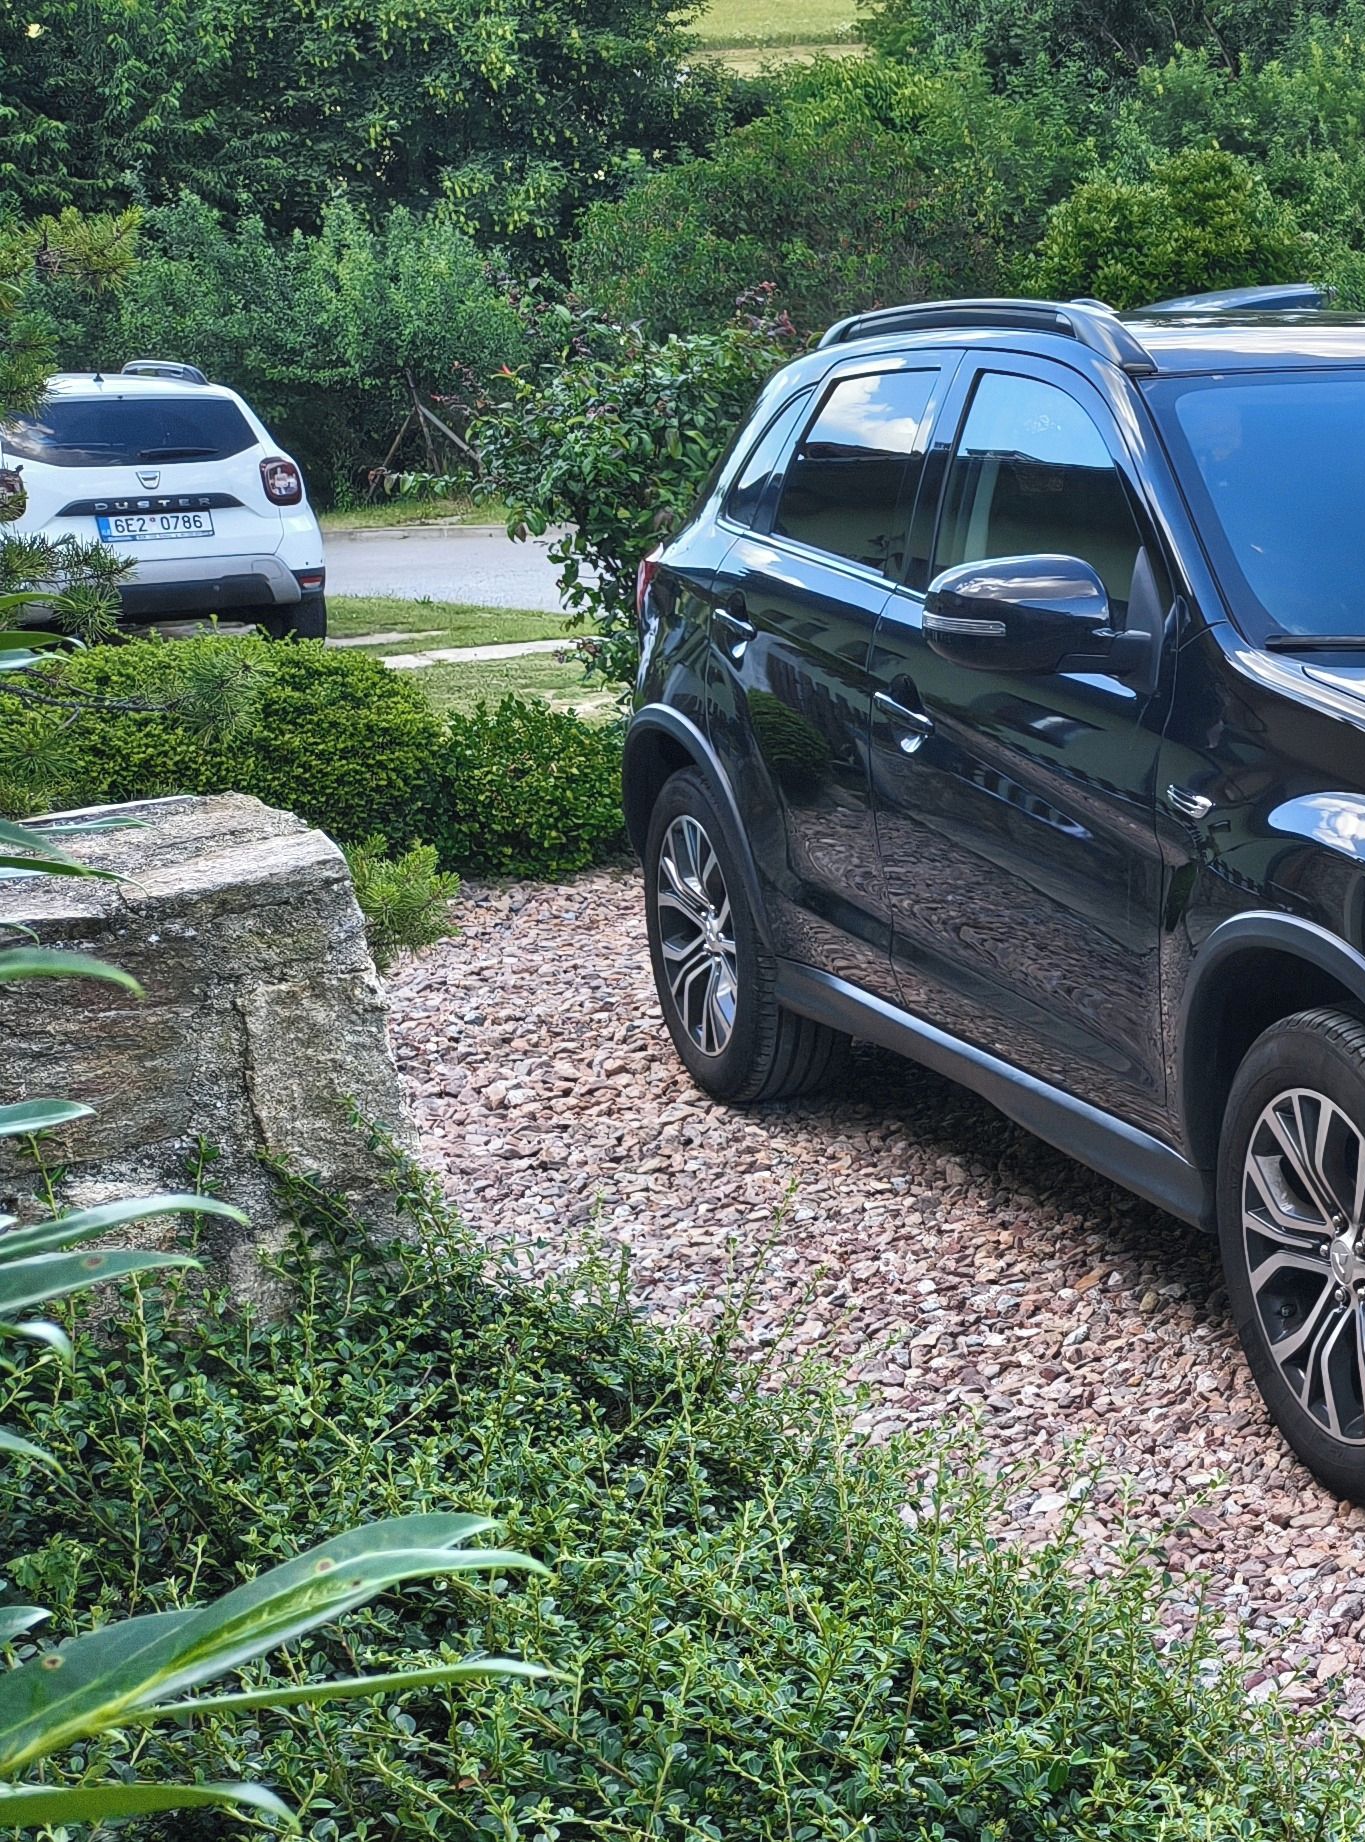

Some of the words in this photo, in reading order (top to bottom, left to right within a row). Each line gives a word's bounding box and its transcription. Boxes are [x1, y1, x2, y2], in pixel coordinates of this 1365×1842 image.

[94, 497, 211, 511] DUSTER
[114, 517, 149, 534] 6E2
[160, 514, 203, 531] 0786
